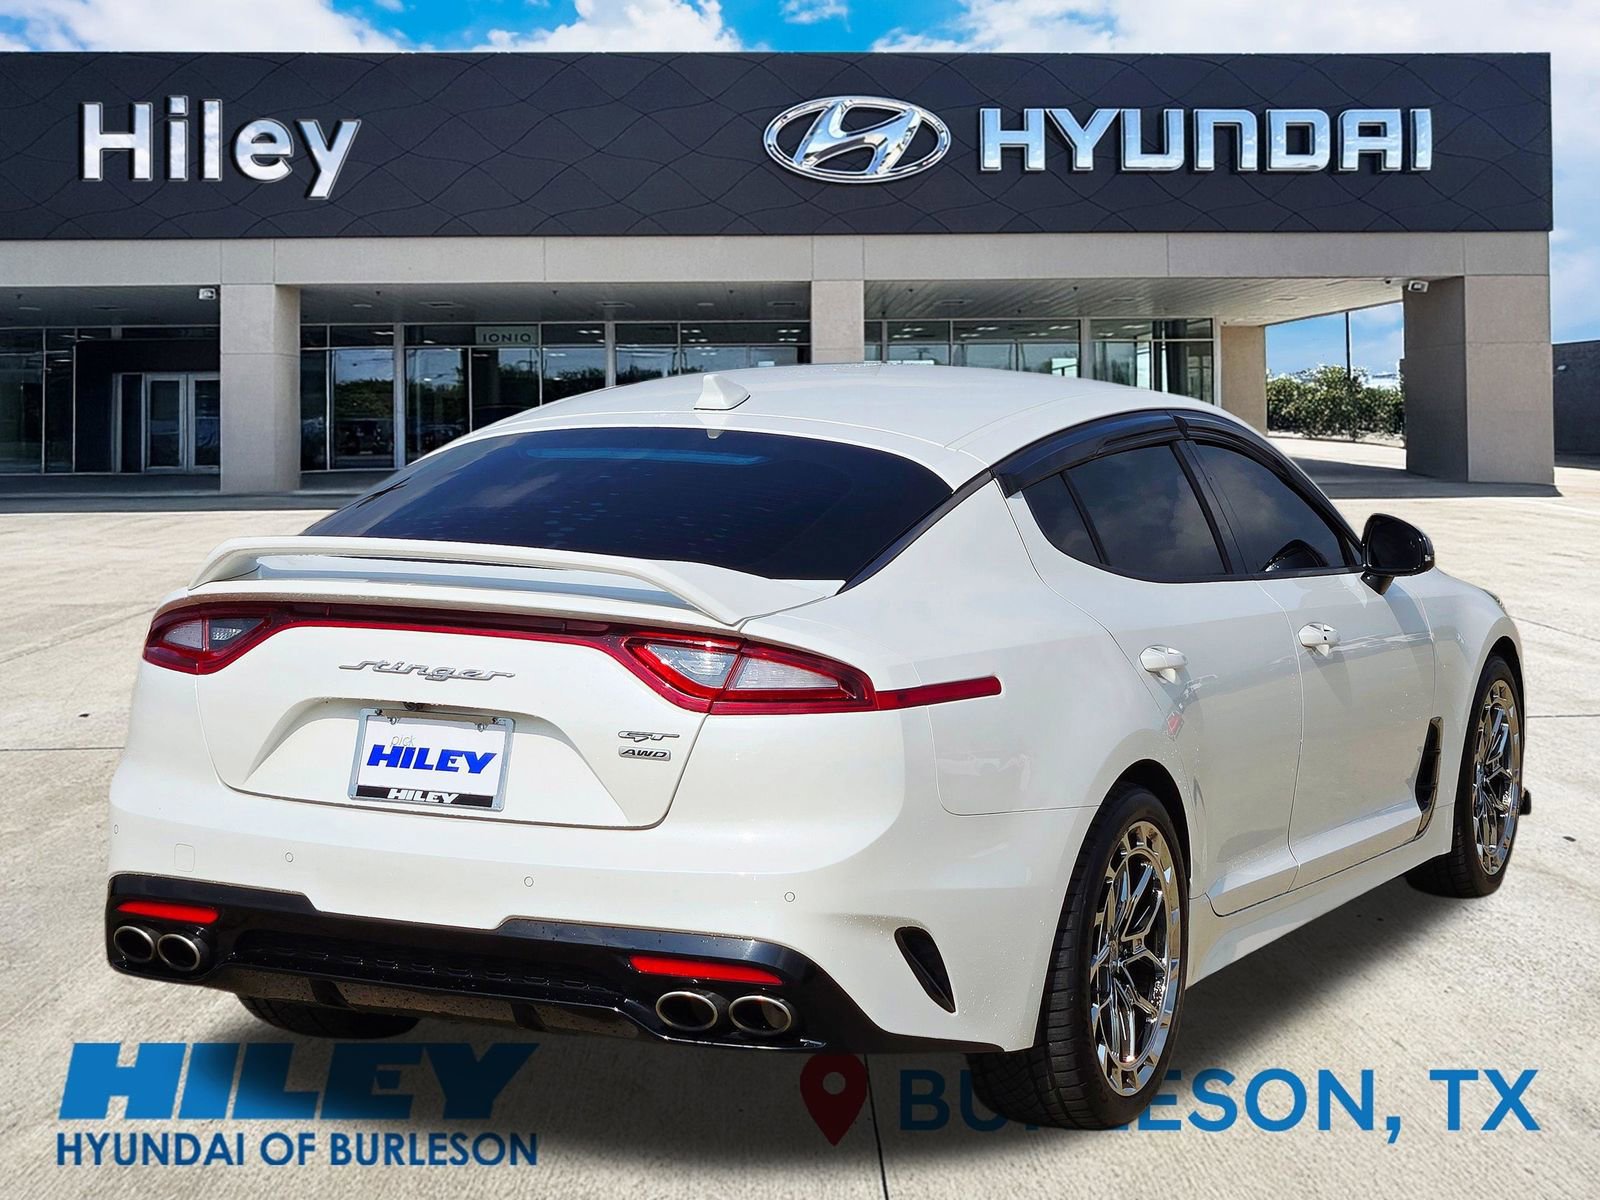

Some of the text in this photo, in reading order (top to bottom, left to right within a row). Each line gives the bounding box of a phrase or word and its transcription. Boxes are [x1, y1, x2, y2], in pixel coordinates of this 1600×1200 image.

[79, 95, 362, 200] Hiley
[979, 107, 1432, 172] HYUNDAI
[367, 744, 497, 774] HILEY
[621, 748, 668, 758] AWD
[387, 788, 459, 804] HILEY
